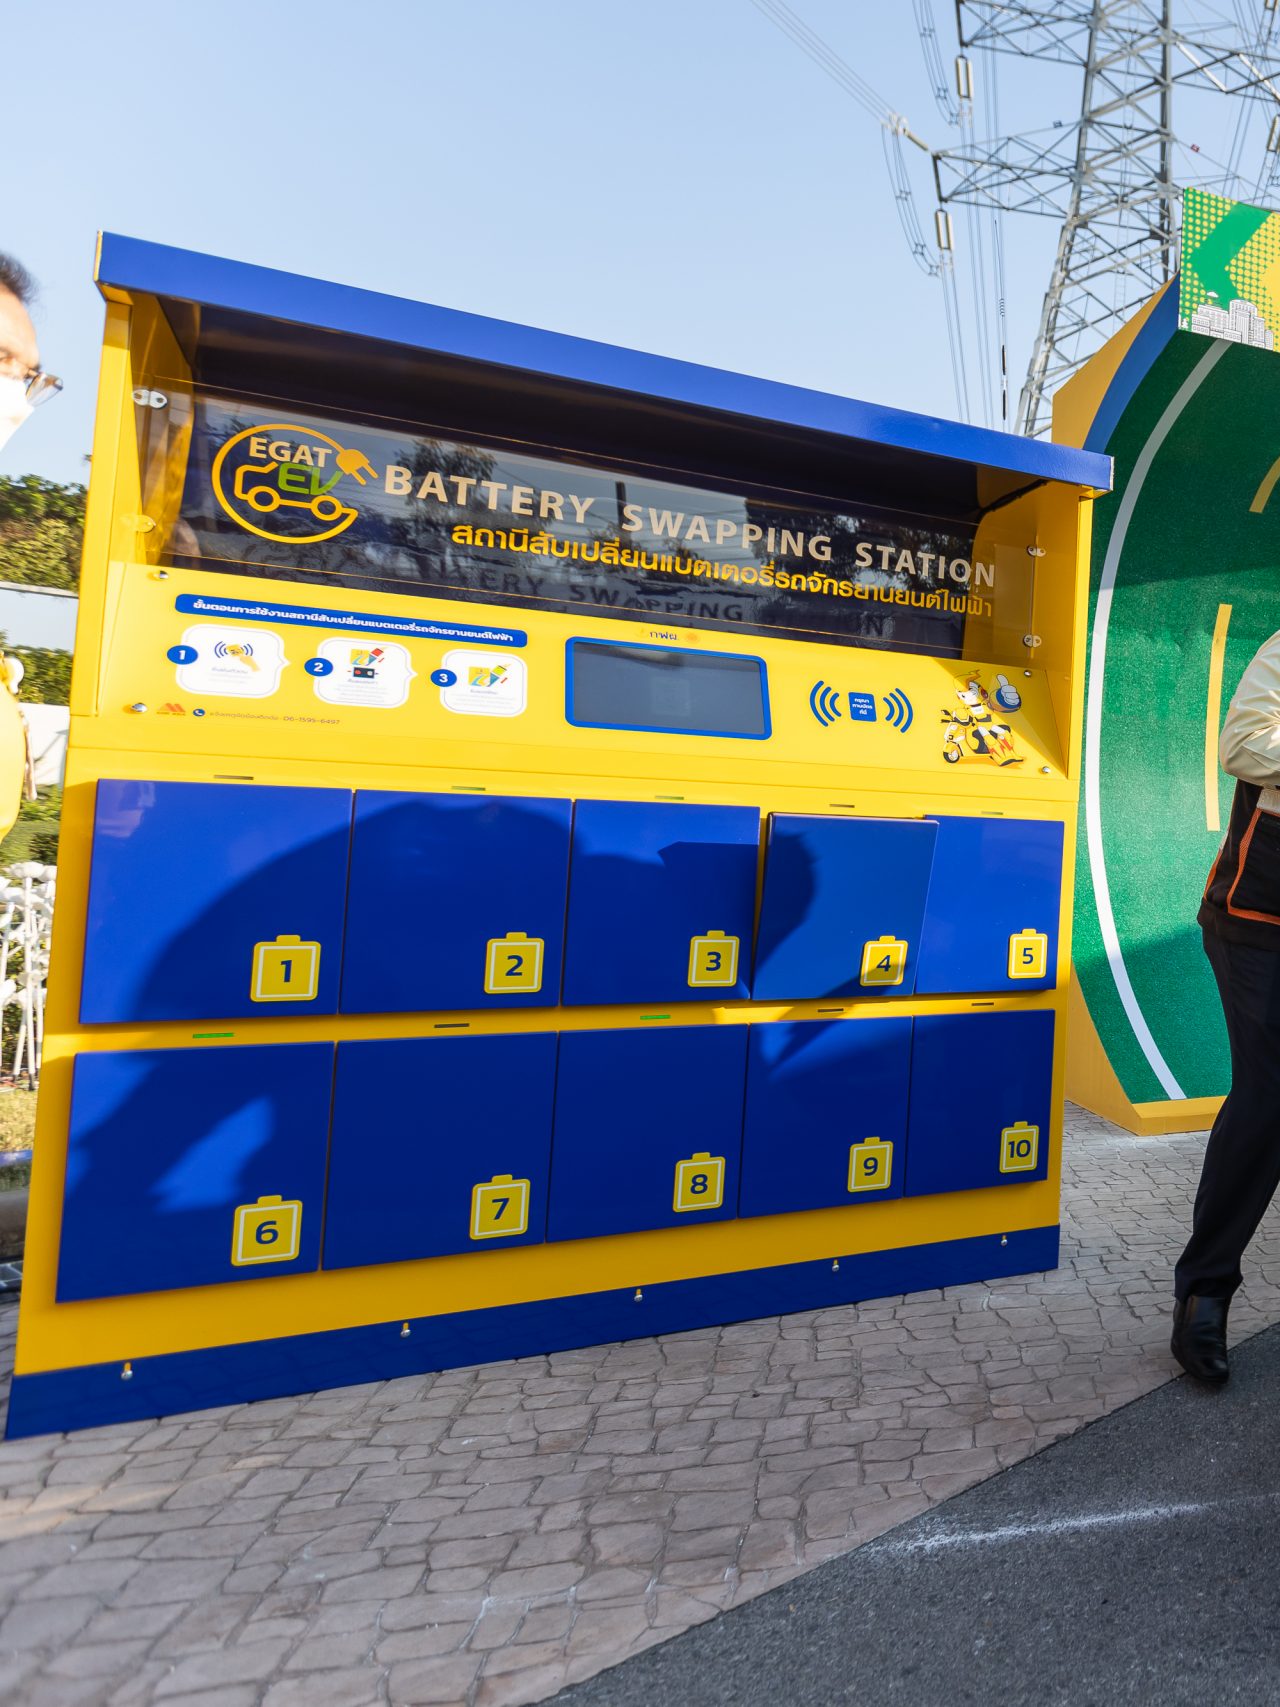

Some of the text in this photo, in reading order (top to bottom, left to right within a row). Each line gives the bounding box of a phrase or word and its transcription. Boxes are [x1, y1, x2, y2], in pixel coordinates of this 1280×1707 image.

[248, 436, 332, 468] EGAT
[277, 462, 345, 496] EV
[384, 464, 996, 588] BATTERY SWAPPING STATION
[178, 649, 187, 661] 1
[313, 661, 324, 673] 2
[438, 673, 449, 684] 3
[505, 954, 524, 977] 2
[706, 951, 722, 972] 3
[876, 954, 893, 972] 4
[1022, 947, 1034, 965] 5
[280, 959, 293, 983] 1
[1007, 1138, 1032, 1160] 10
[862, 1156, 879, 1177] 9
[690, 1173, 709, 1195] 8
[491, 1197, 511, 1221] 7
[254, 1220, 279, 1245] 6
